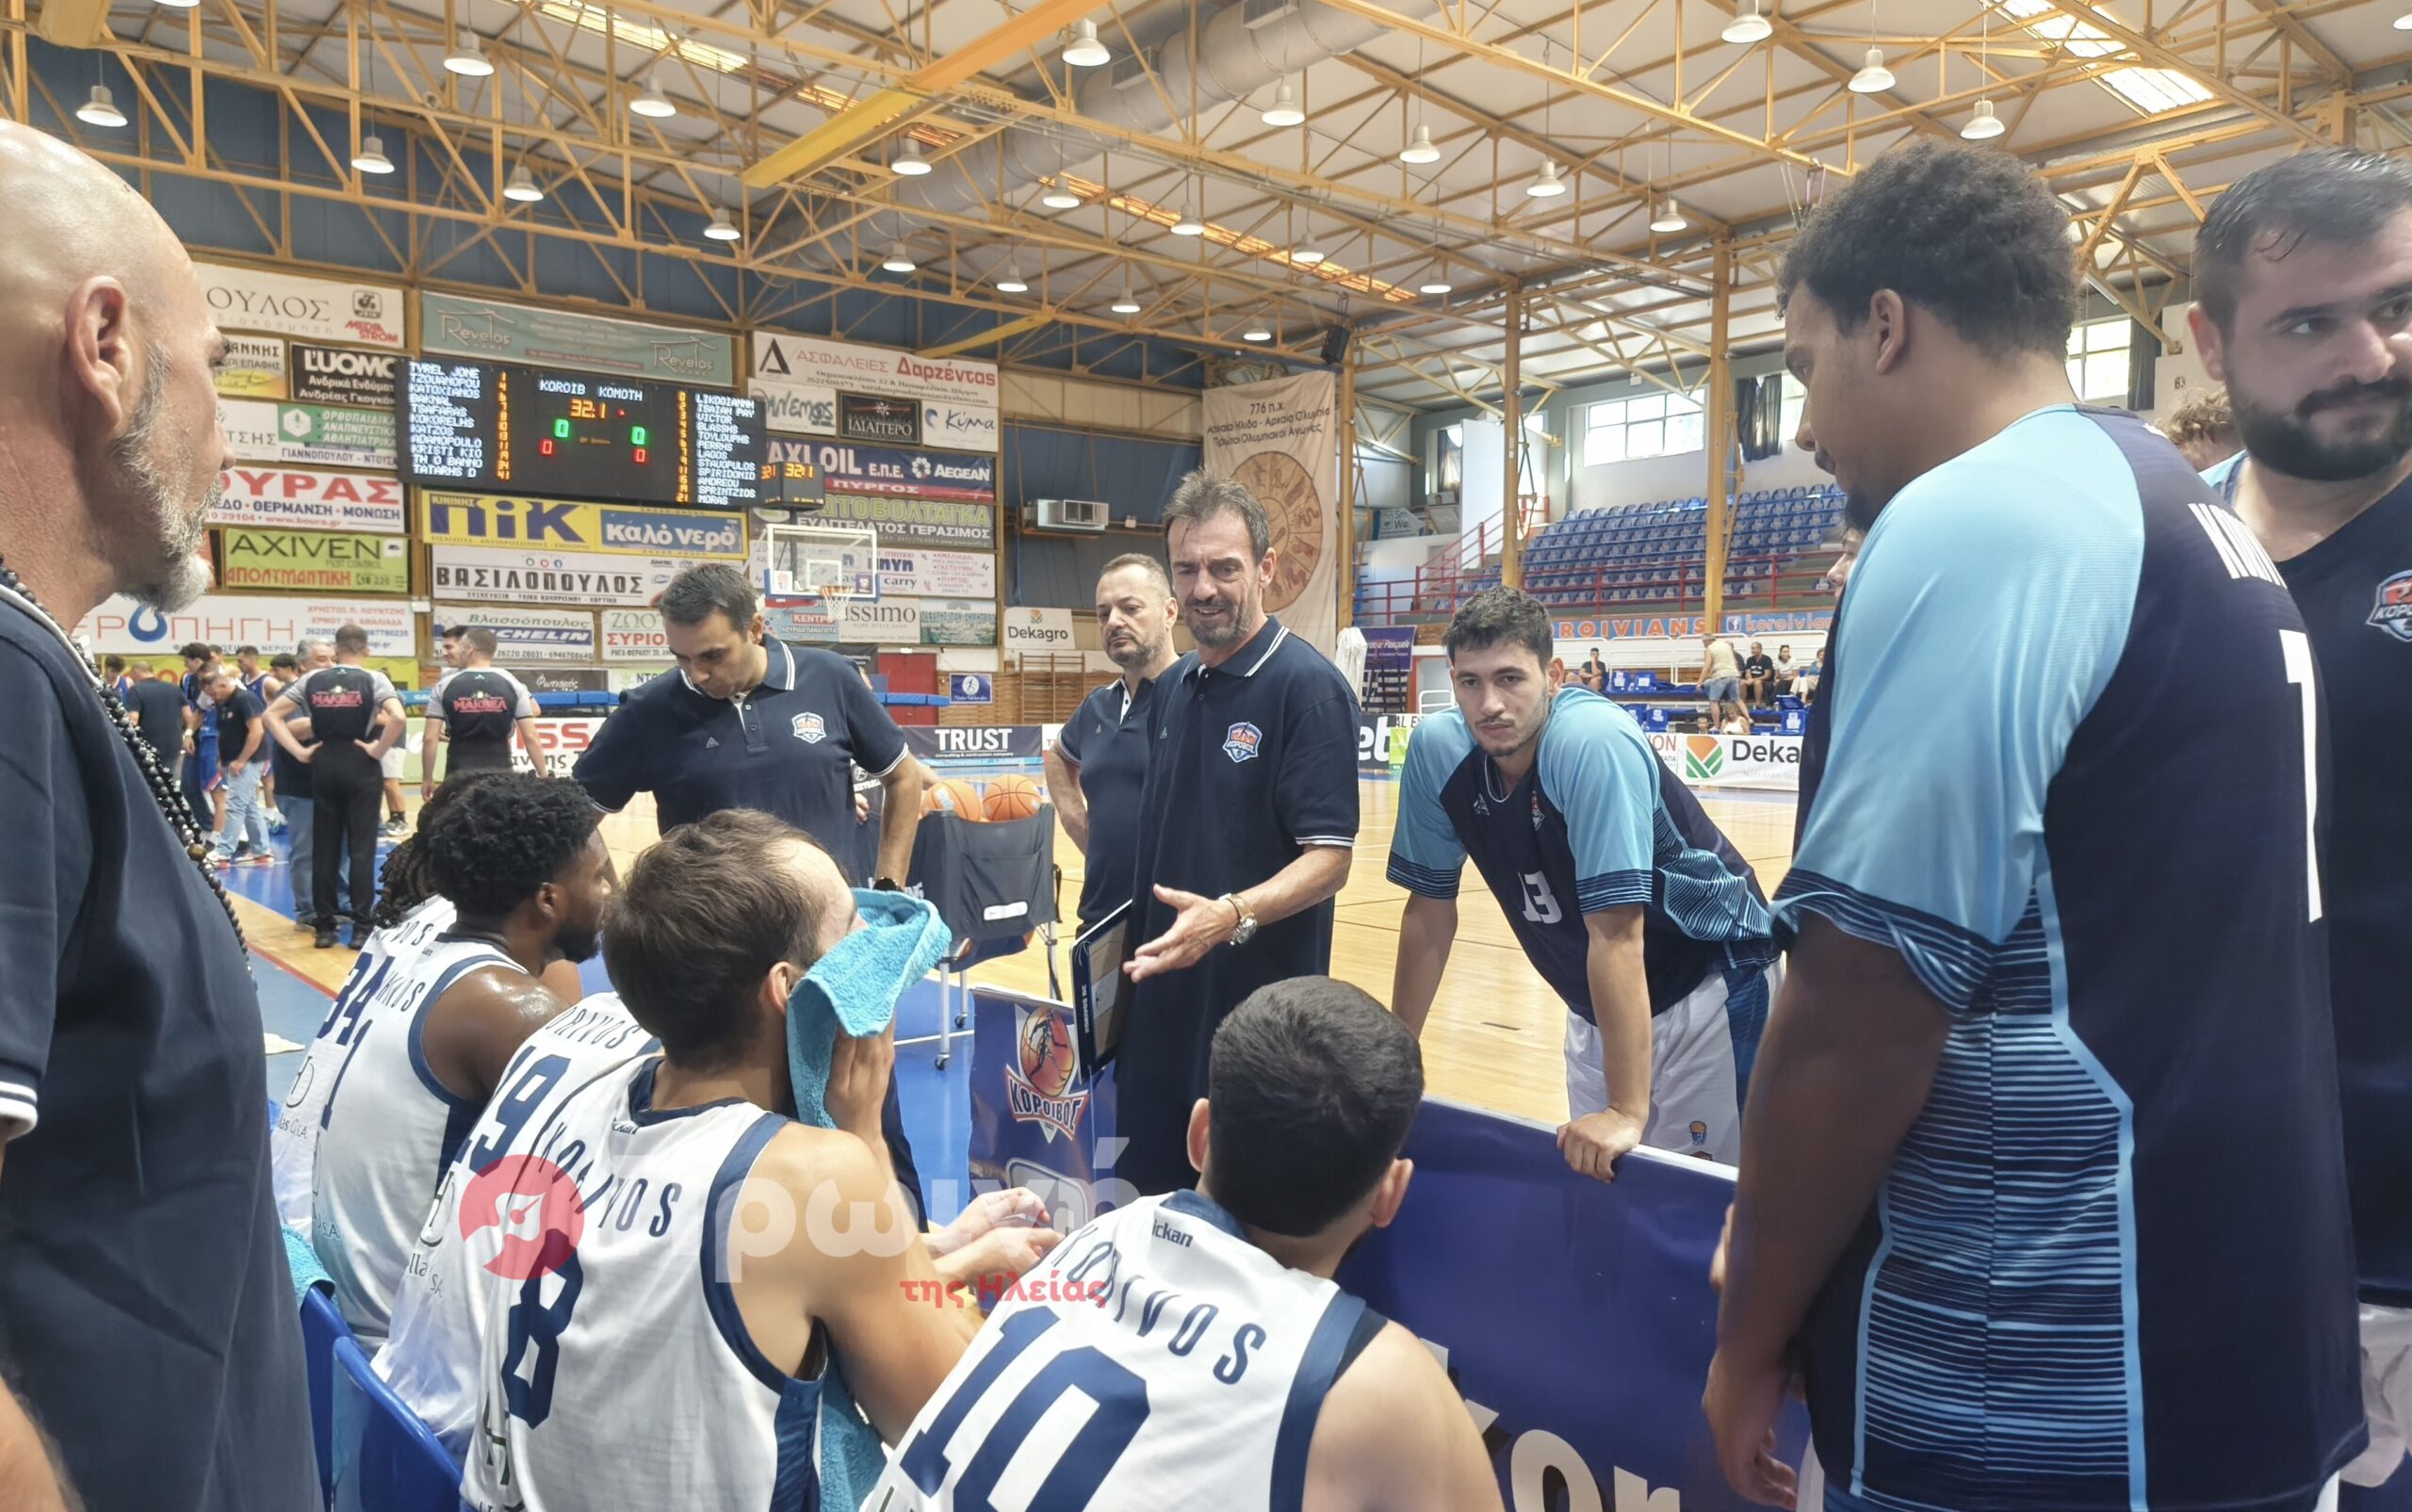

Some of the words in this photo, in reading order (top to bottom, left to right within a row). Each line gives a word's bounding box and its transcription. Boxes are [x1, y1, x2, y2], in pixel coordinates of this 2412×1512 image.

[797, 350, 889, 373] ΑΣΦΑΛΕΙΕΣ
[897, 357, 996, 386] Δαρζέντας
[539, 379, 586, 395] KOROIB
[597, 385, 643, 401] KOMOTH
[819, 447, 862, 476] OIL
[833, 480, 920, 495] ΠΥΡΓΟΣ
[253, 500, 332, 515] ΘΕΡΜΑΝΣΗ
[343, 507, 399, 520] ΜΟΝΩΣΗ
[910, 525, 990, 539] ΓΕΡΑΣΙΜΟΣ
[230, 534, 382, 561] AXIVEN
[436, 566, 644, 594] ΒΑΣΙΛΟΠΟΥΛΟΣ
[884, 577, 917, 589] carry
[490, 628, 589, 642] CHELIN
[1008, 626, 1067, 642] Dekagro
[935, 728, 1013, 750] TRUST
[1518, 870, 1563, 924] 13
[1009, 1078, 1083, 1132] ΚΟΡΟΙΒΟΣ
[900, 1307, 1150, 1512] 10
